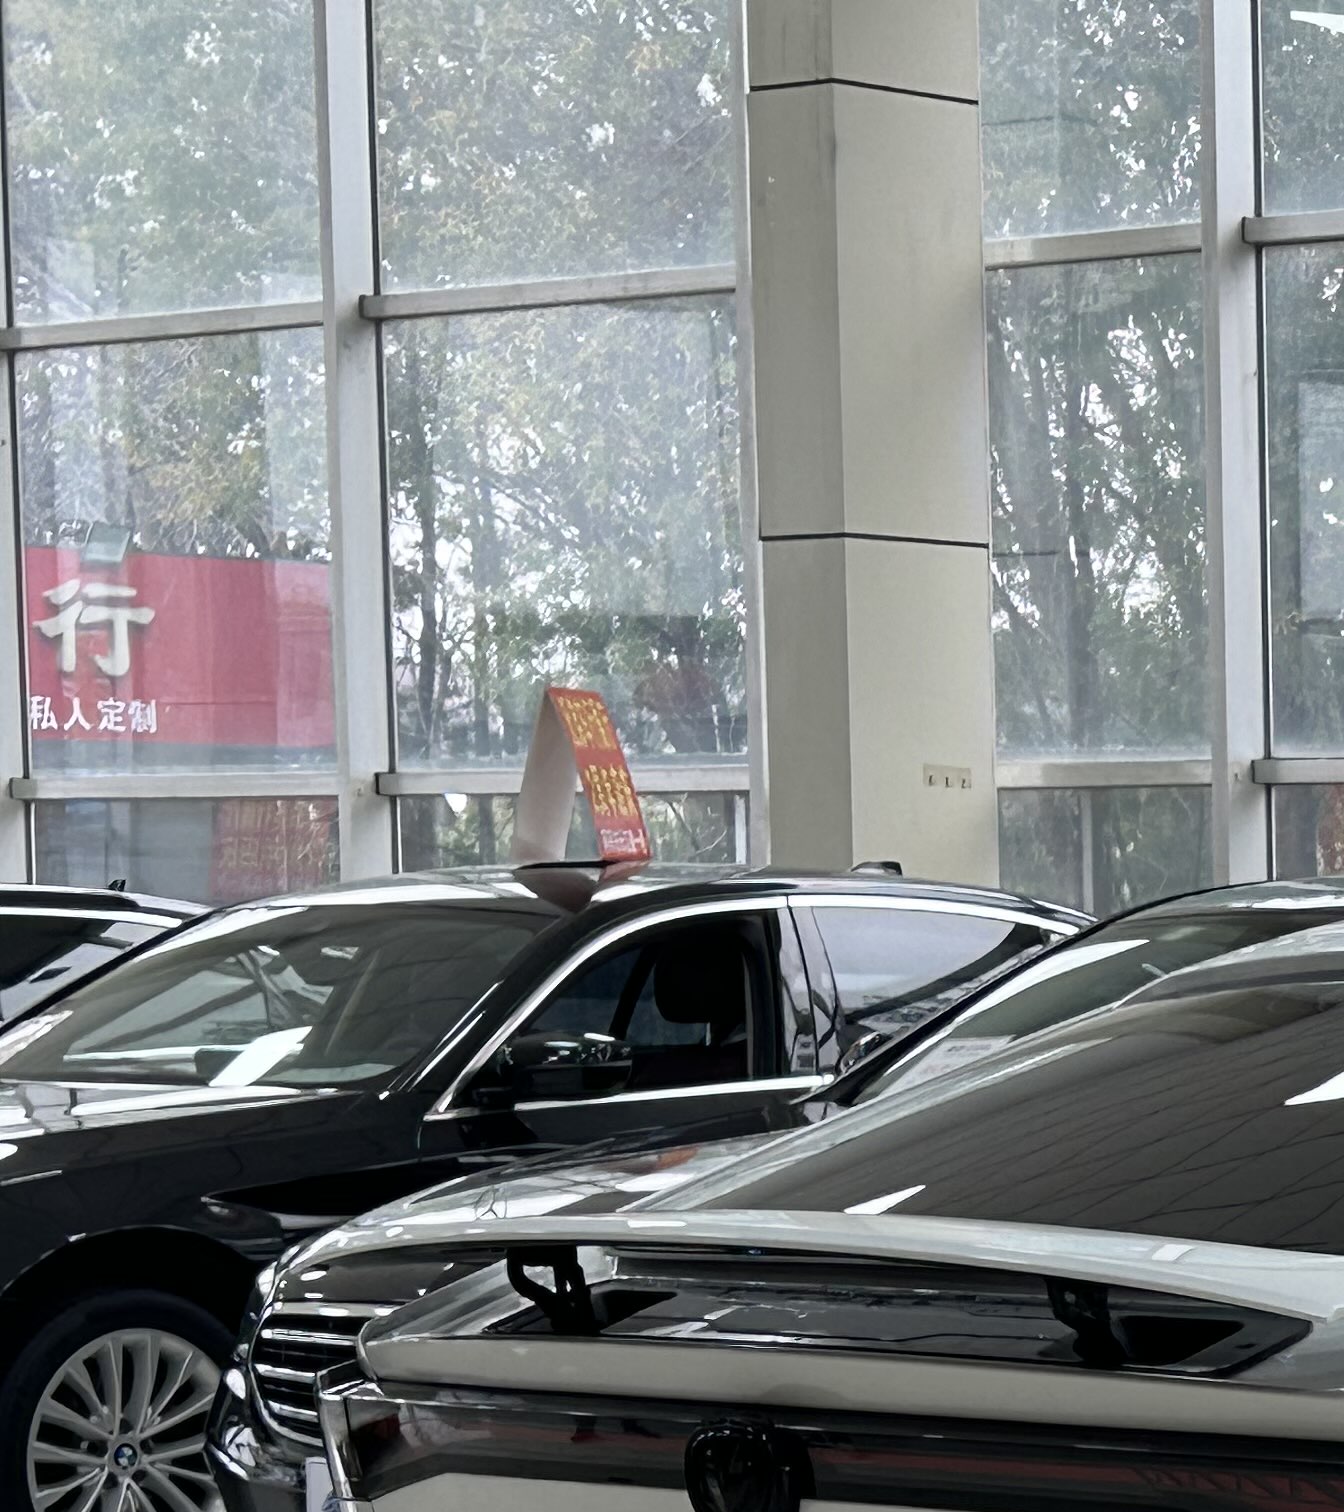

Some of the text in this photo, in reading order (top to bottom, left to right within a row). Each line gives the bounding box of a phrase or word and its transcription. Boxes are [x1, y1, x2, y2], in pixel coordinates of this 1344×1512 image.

[32, 578, 156, 677] 行
[30, 695, 157, 733] 私人定制
